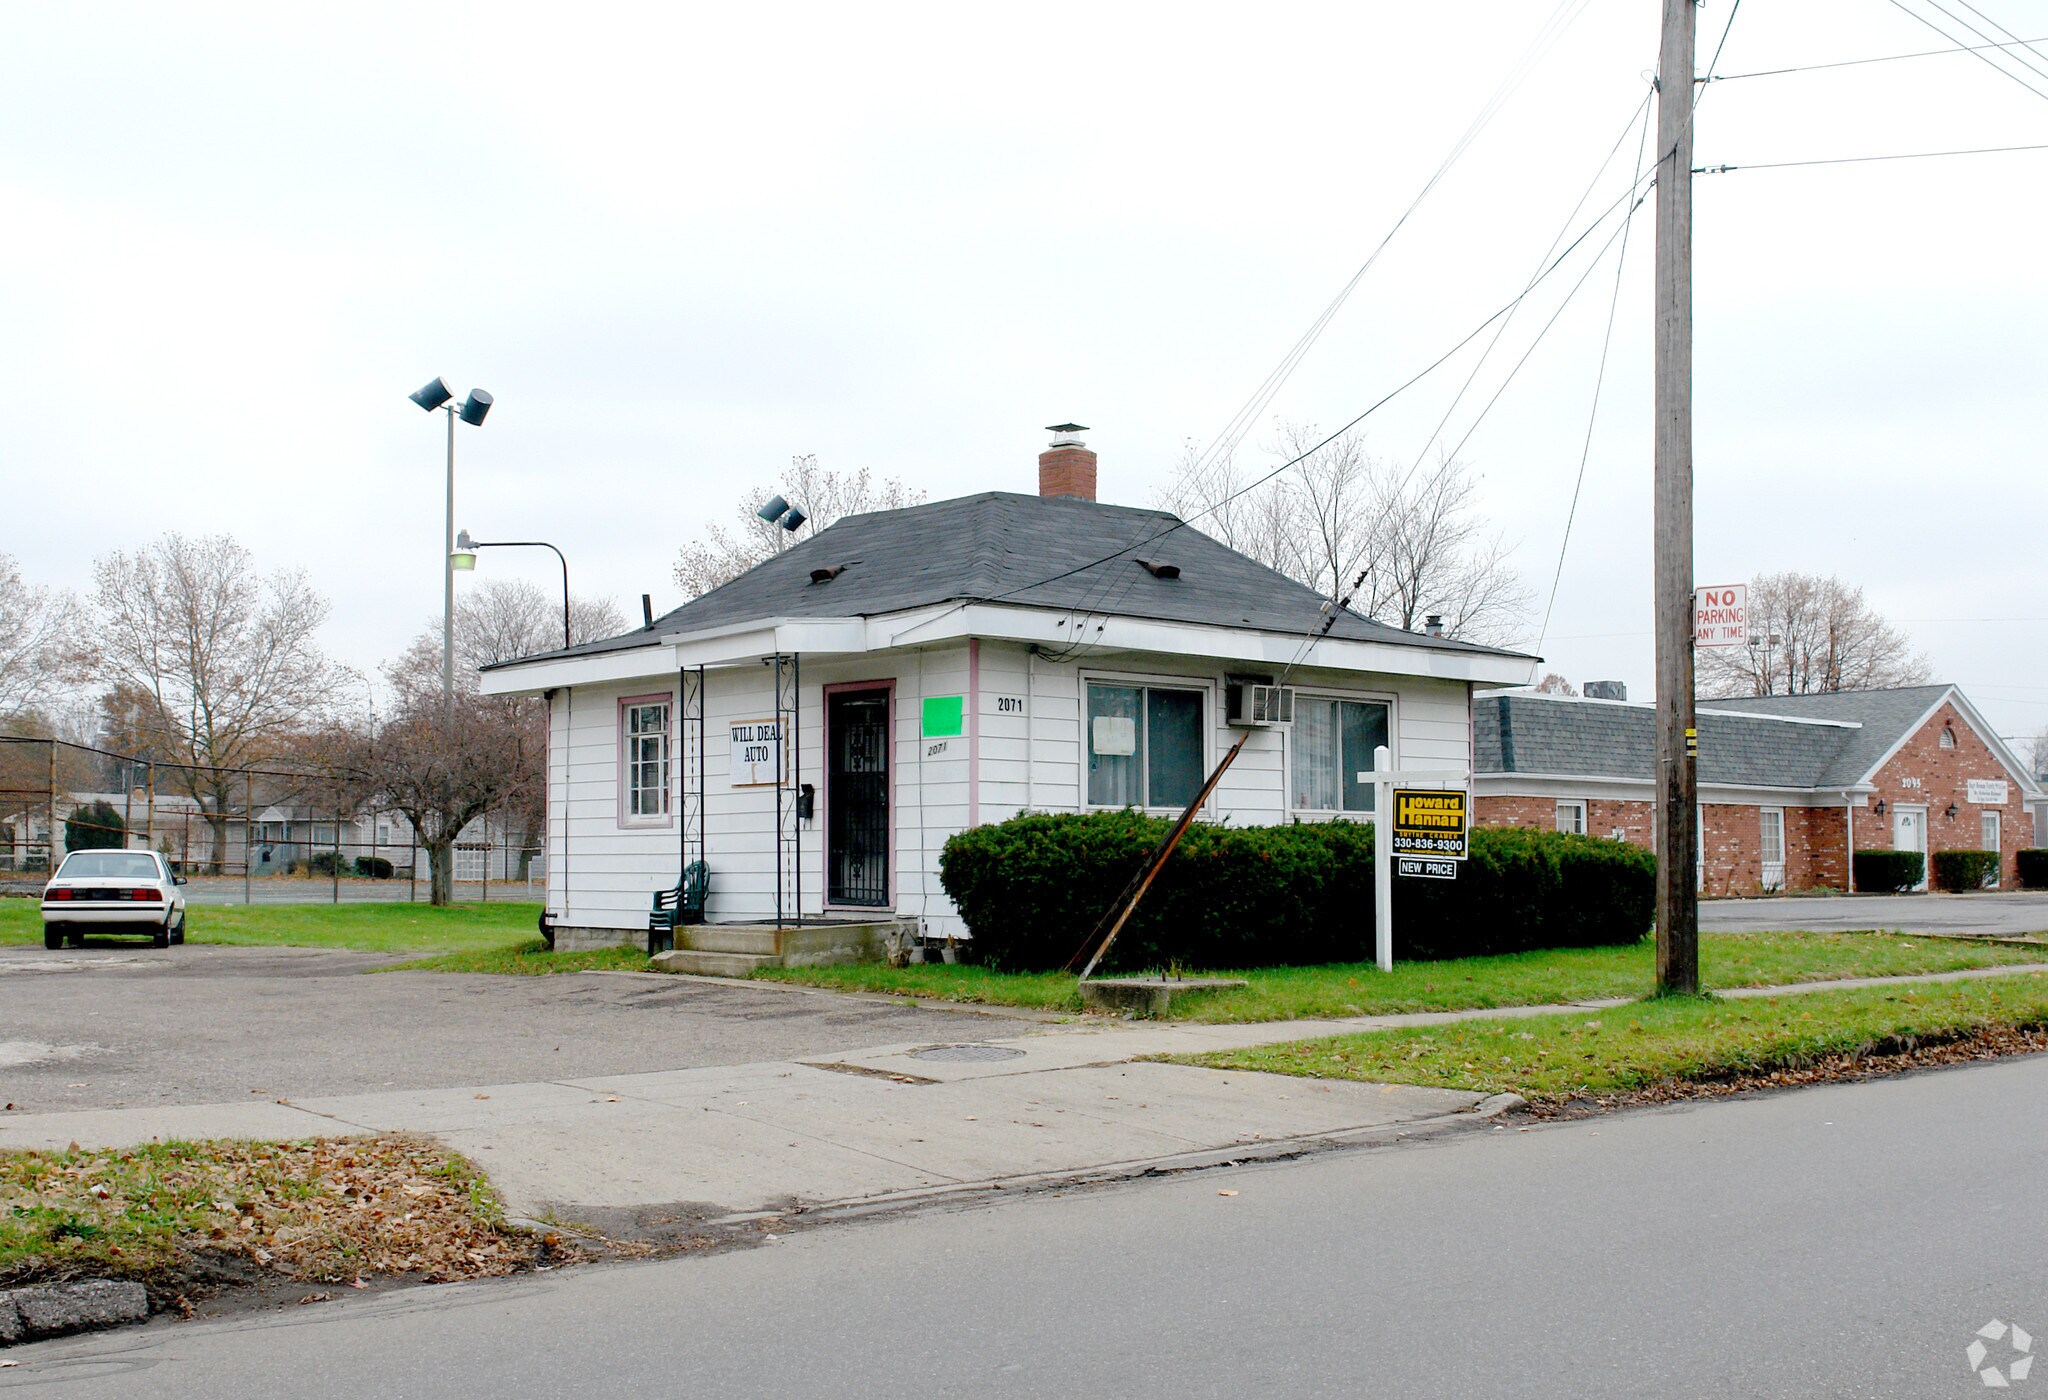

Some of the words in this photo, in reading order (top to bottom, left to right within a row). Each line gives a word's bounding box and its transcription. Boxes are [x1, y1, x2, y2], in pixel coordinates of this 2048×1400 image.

[1705, 590, 1736, 607] NO
[1697, 608, 1744, 624] PARKING
[1697, 627, 1715, 640] ANY
[1722, 626, 1743, 639] TIME
[998, 697, 1022, 712] 2071
[732, 726, 754, 743] WILL
[744, 746, 769, 762] AUTO
[927, 741, 948, 757] 2071
[1394, 837, 1463, 851] 330-836-9300
[1401, 861, 1422, 873] NEW
[1426, 863, 1453, 875] PRICE
